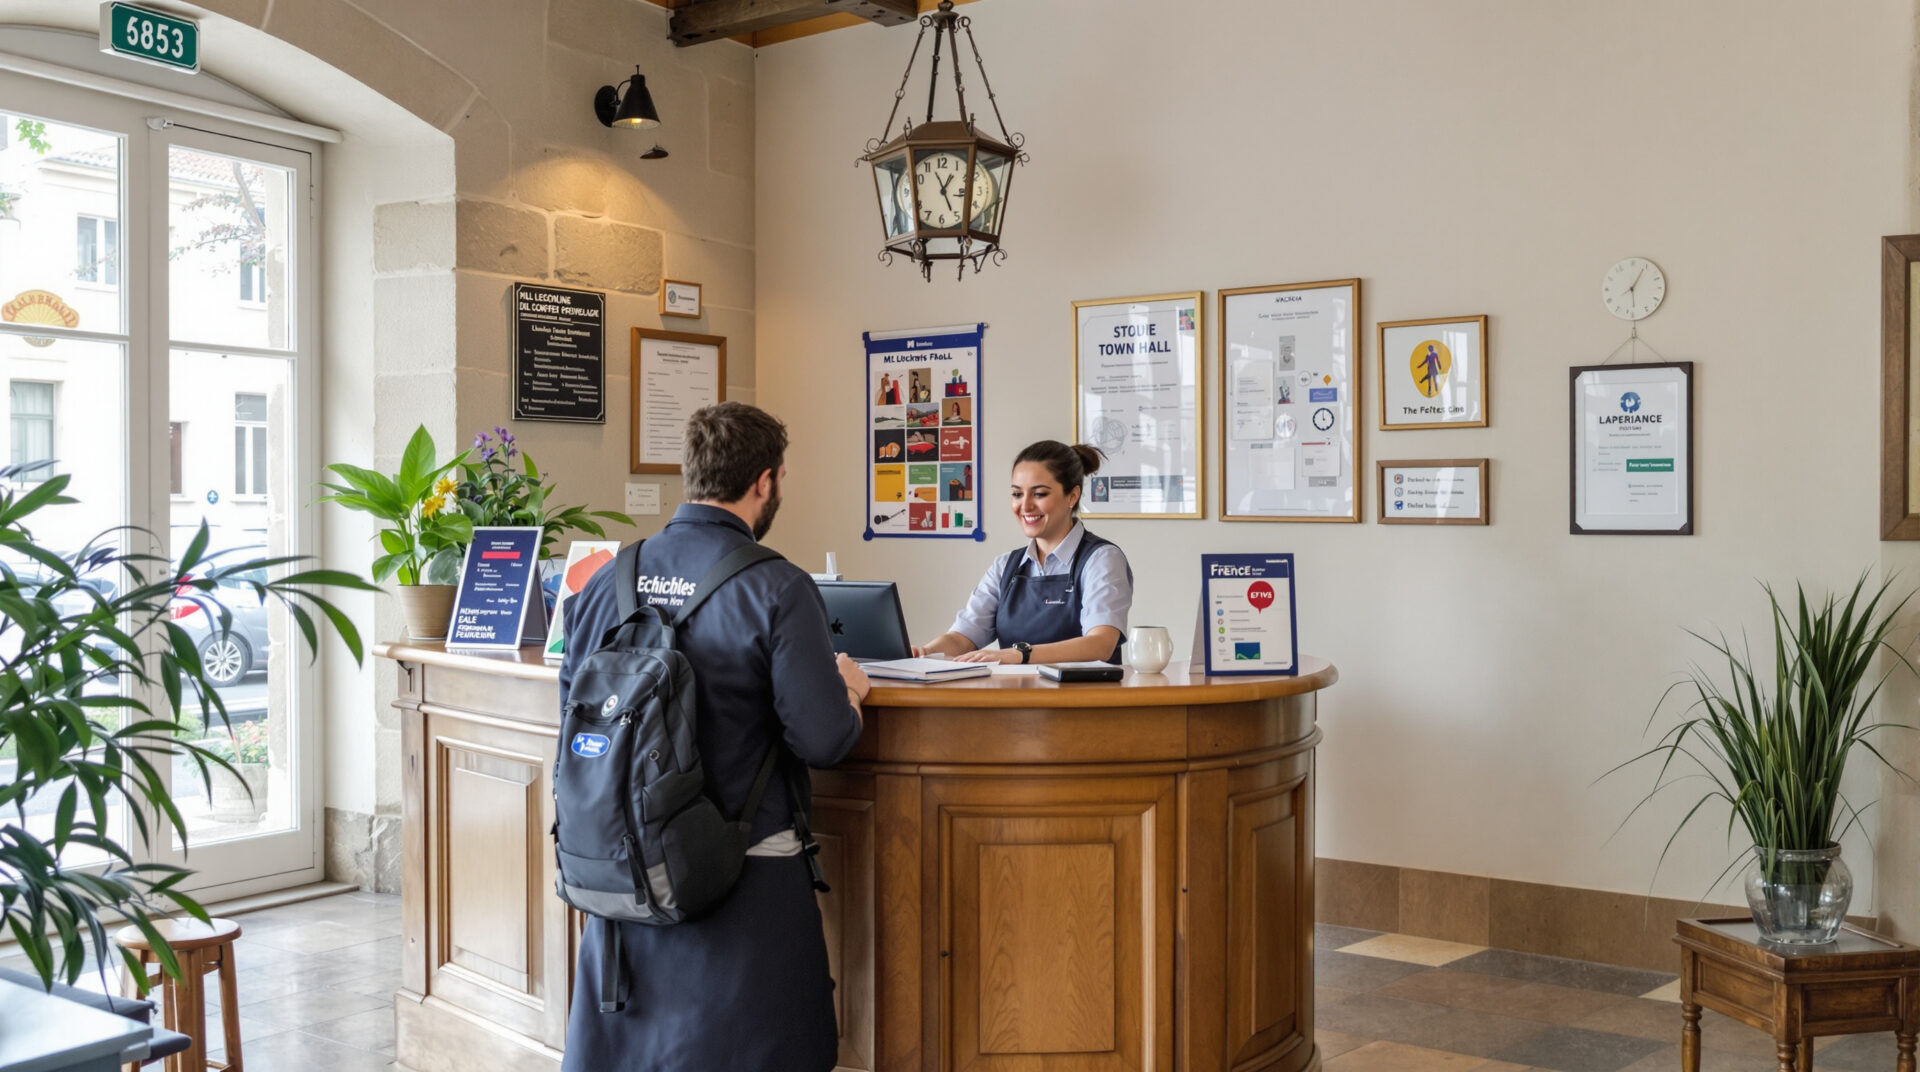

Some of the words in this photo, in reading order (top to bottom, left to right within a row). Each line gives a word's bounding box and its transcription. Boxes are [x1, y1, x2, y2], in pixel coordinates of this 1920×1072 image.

[937, 157, 948, 169] 12
[939, 214, 945, 224] 6
[1098, 342, 1135, 356] TOWN
[1139, 340, 1172, 354] HALL
[1402, 406, 1417, 415] The
[1599, 414, 1663, 424] LAPERIANCE
